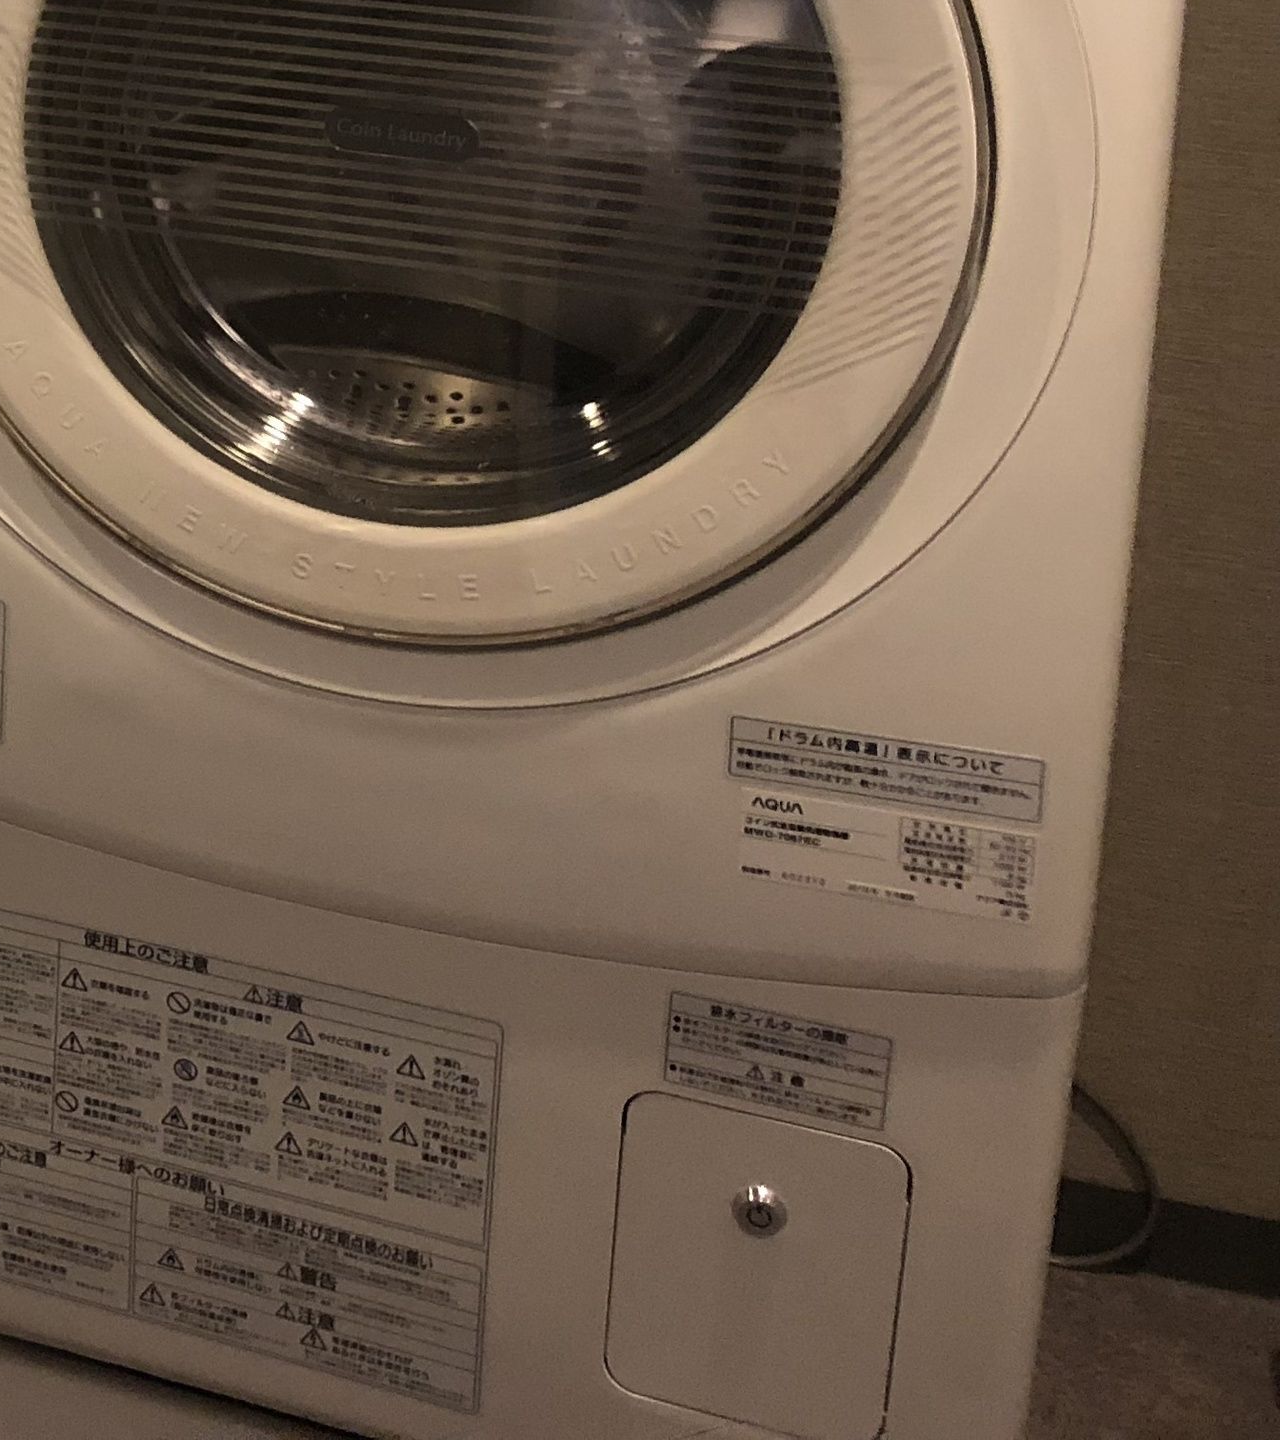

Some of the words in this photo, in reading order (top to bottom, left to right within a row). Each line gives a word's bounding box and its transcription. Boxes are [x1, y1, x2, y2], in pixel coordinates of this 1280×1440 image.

[532, 450, 793, 596] LAUNDRY
[752, 796, 804, 815] AQUA
[84, 930, 209, 974] 使用上のご注意
[265, 988, 304, 1014] 注意
[49, 1140, 226, 1195] オーナー様へのお願い
[299, 1265, 338, 1292] 警告
[298, 1305, 336, 1331] 注意
